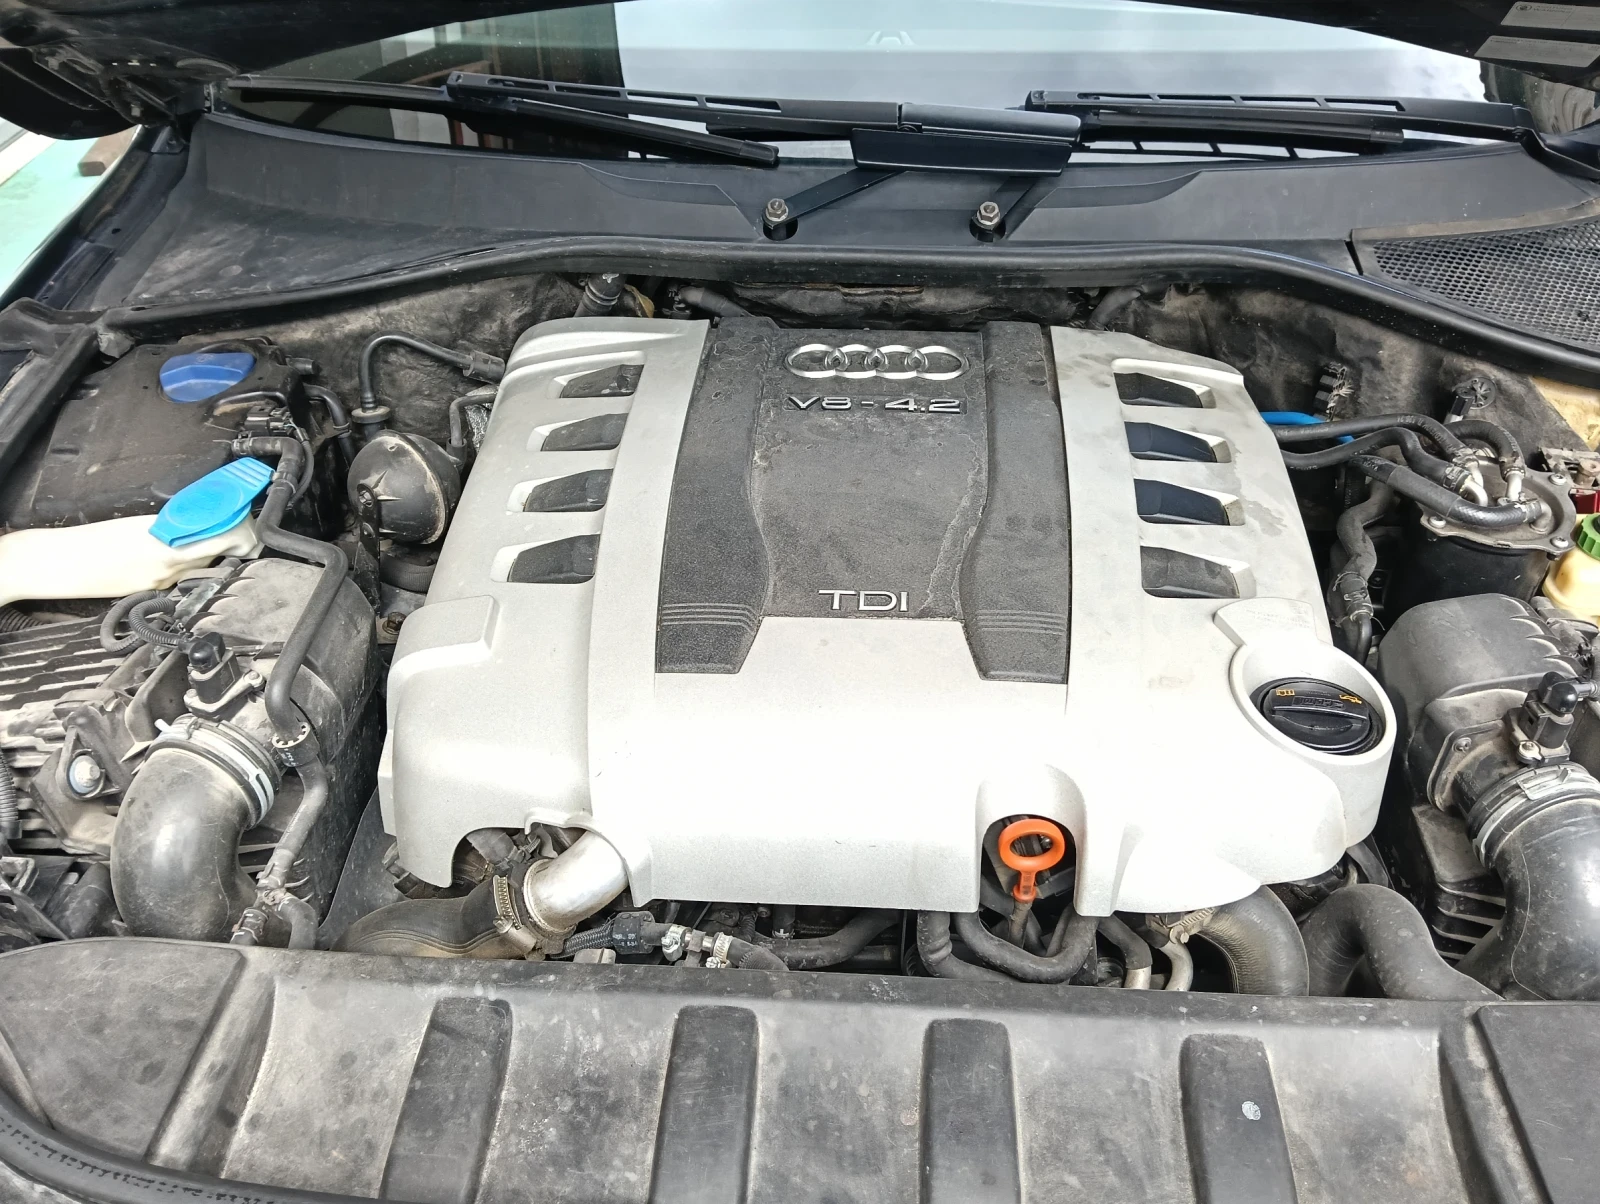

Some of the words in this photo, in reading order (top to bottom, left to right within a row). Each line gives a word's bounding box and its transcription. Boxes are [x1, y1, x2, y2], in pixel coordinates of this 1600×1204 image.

[787, 396, 852, 411] V8
[884, 398, 962, 414] 4.2
[818, 589, 909, 612] TDI
